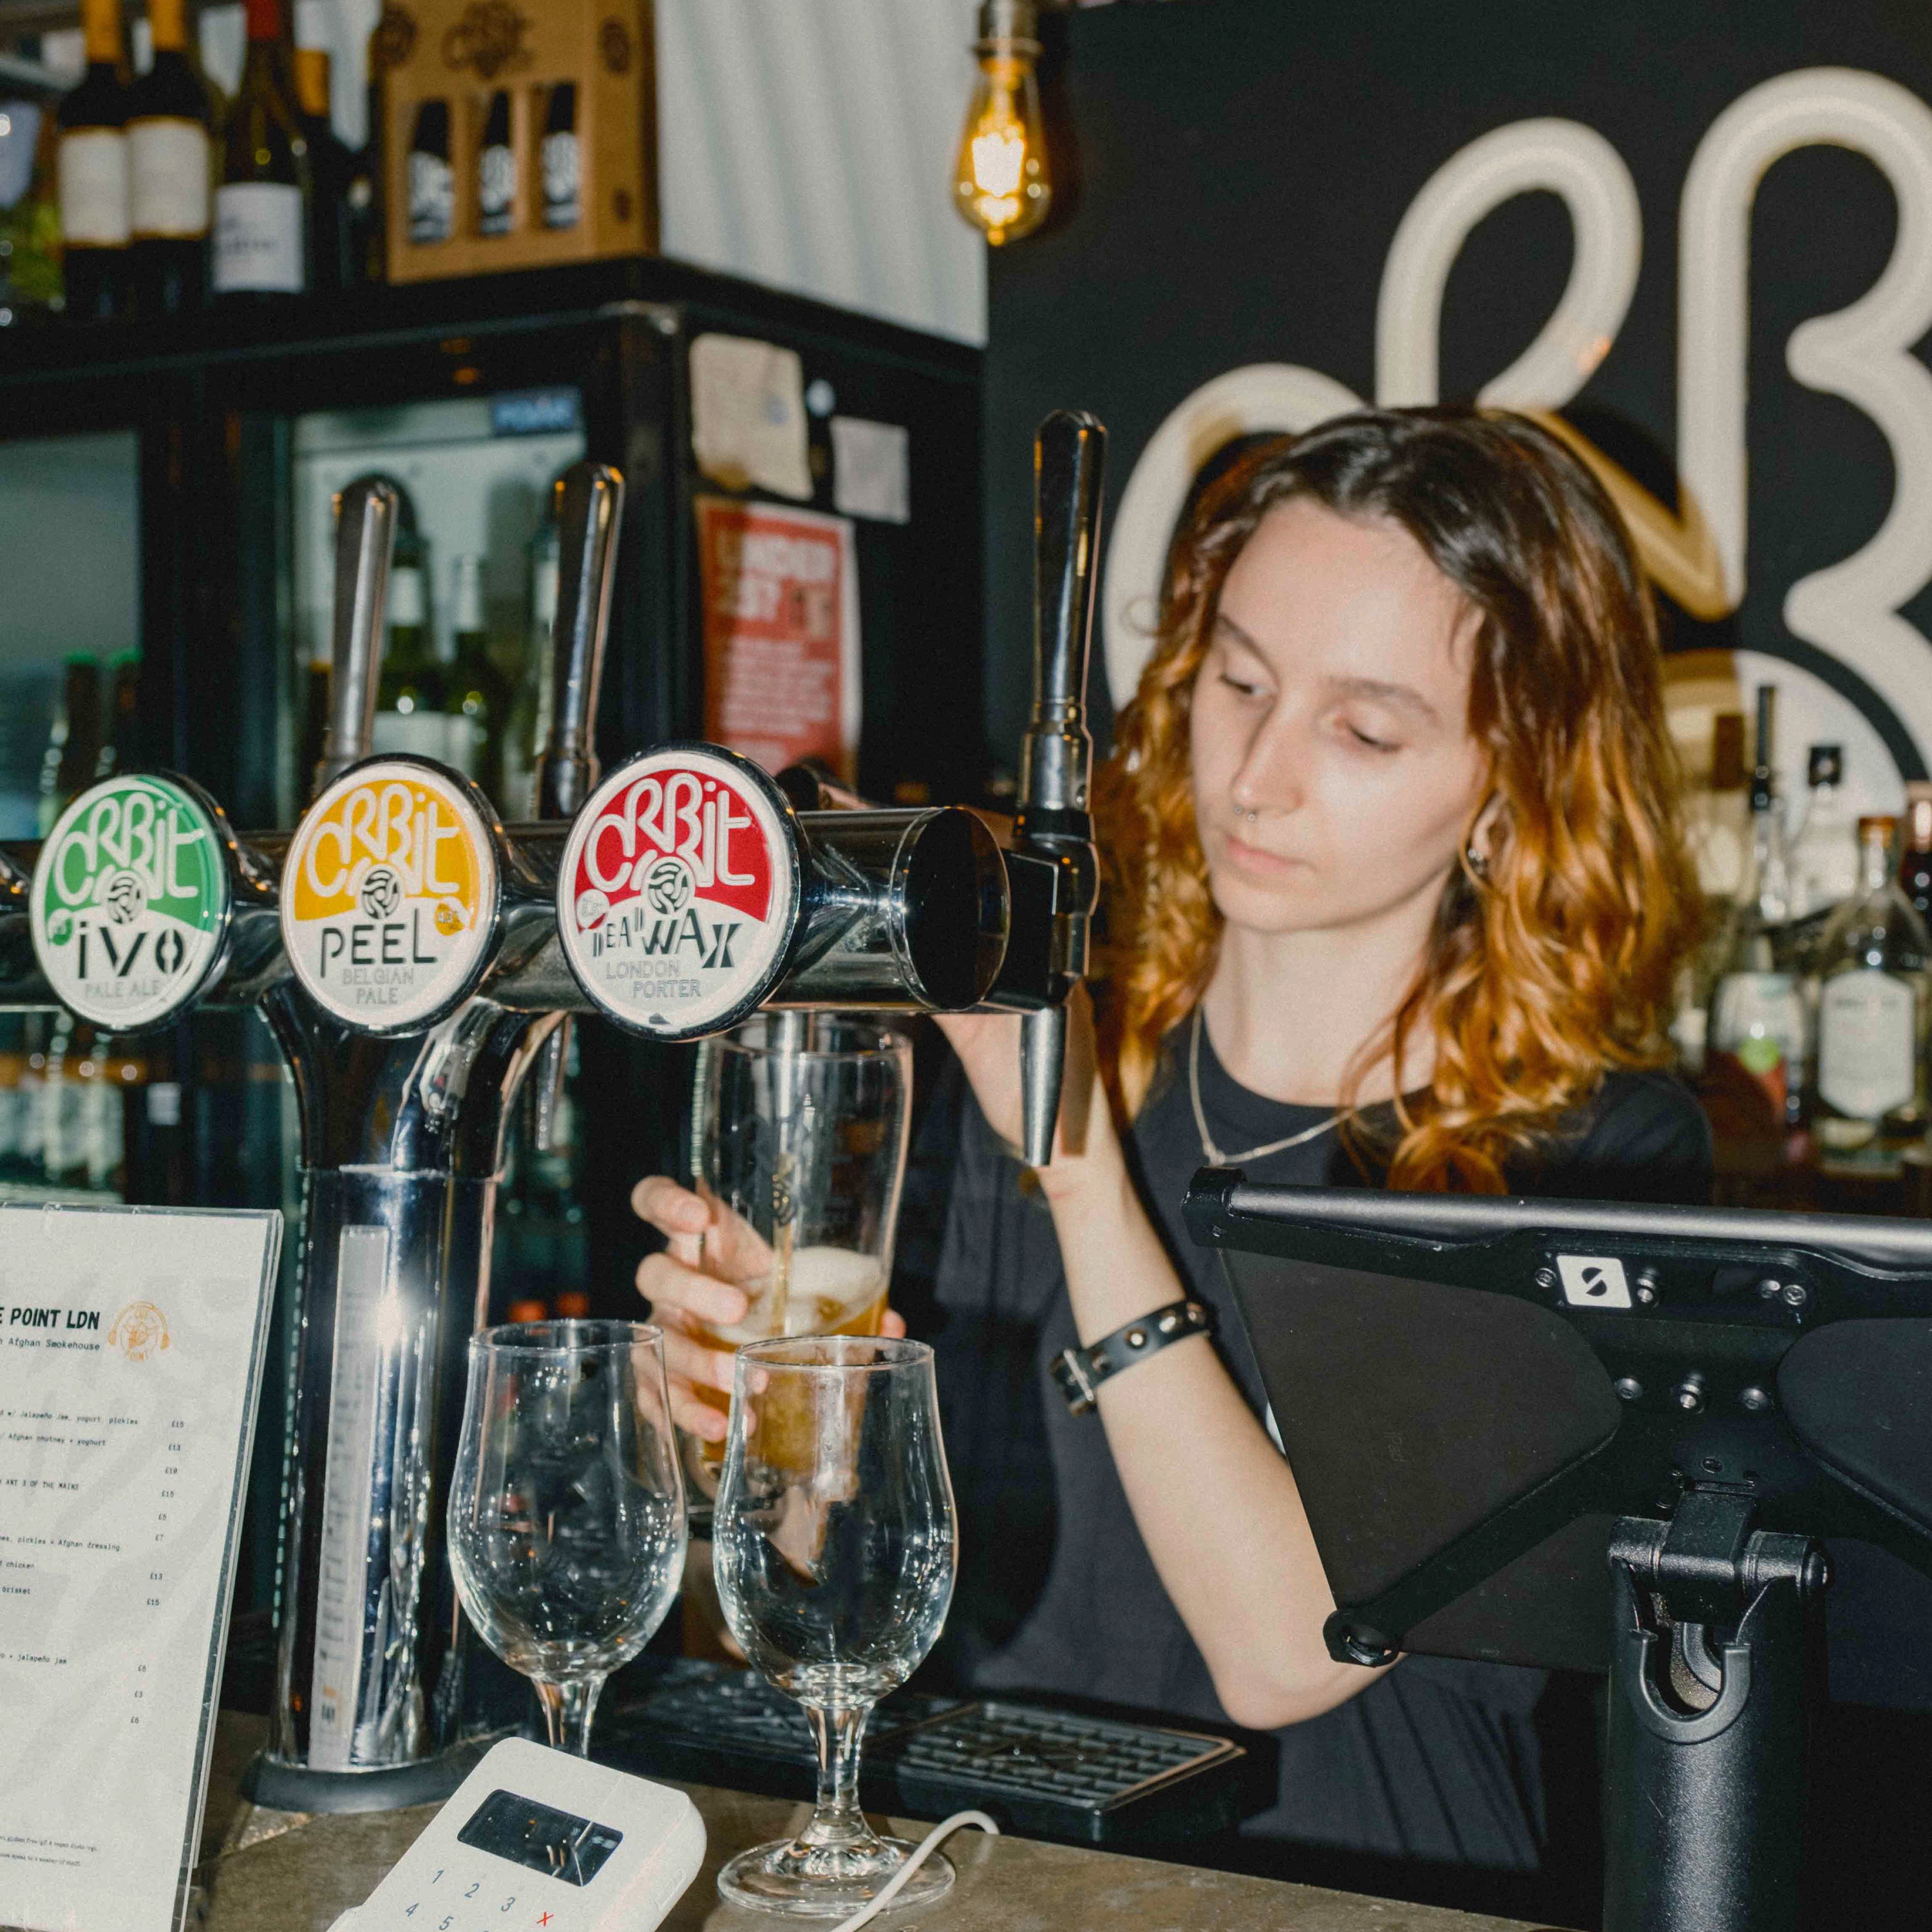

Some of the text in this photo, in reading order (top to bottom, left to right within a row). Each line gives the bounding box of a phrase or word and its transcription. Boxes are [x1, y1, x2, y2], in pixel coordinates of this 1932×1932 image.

[320, 908, 439, 979] PEEL
[641, 908, 743, 969] WAX
[343, 968, 415, 985] BELGIAN
[606, 960, 681, 980] LONDON
[85, 979, 160, 998] PALE ALE
[355, 987, 399, 1005] PALE
[633, 979, 701, 998] PORTER
[10, 1307, 61, 1327] POINT
[66, 1310, 100, 1329] LDN
[8, 1338, 41, 1349] Afghan
[46, 1339, 100, 1351] Smokehouse
[77, 1439, 107, 1447] yoghurt
[43, 1481, 54, 1489] THE
[59, 1482, 79, 1491] MAINS
[58, 1539, 83, 1548] Afghan
[87, 1541, 120, 1553] dressing
[6, 1560, 35, 1571] chicken
[134, 1690, 143, 1698] £3
[432, 1870, 516, 1912] 1 2 3
[405, 1902, 454, 1931] 4 5
